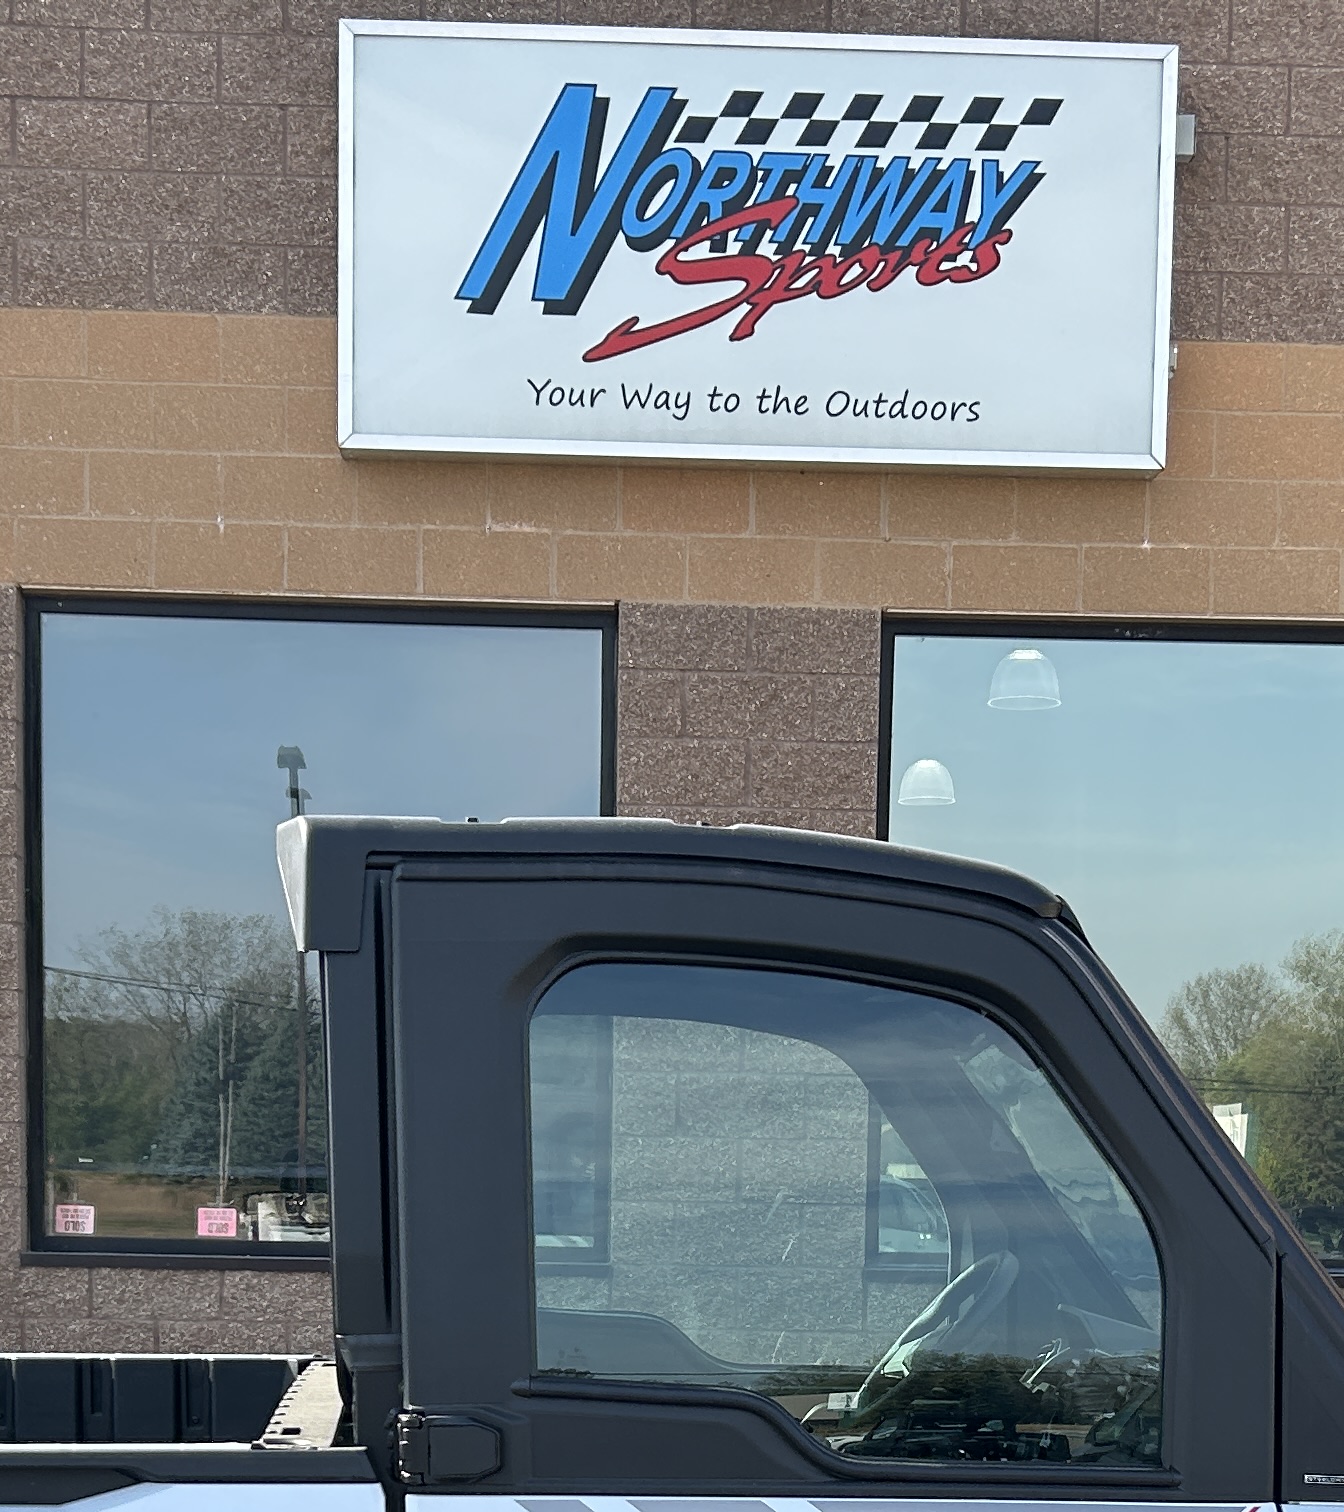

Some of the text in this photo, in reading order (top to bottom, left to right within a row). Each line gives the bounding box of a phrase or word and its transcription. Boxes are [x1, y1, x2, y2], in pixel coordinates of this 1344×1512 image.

[582, 197, 1012, 363] Sports
[527, 378, 981, 423] Your Way to the Outdoors
